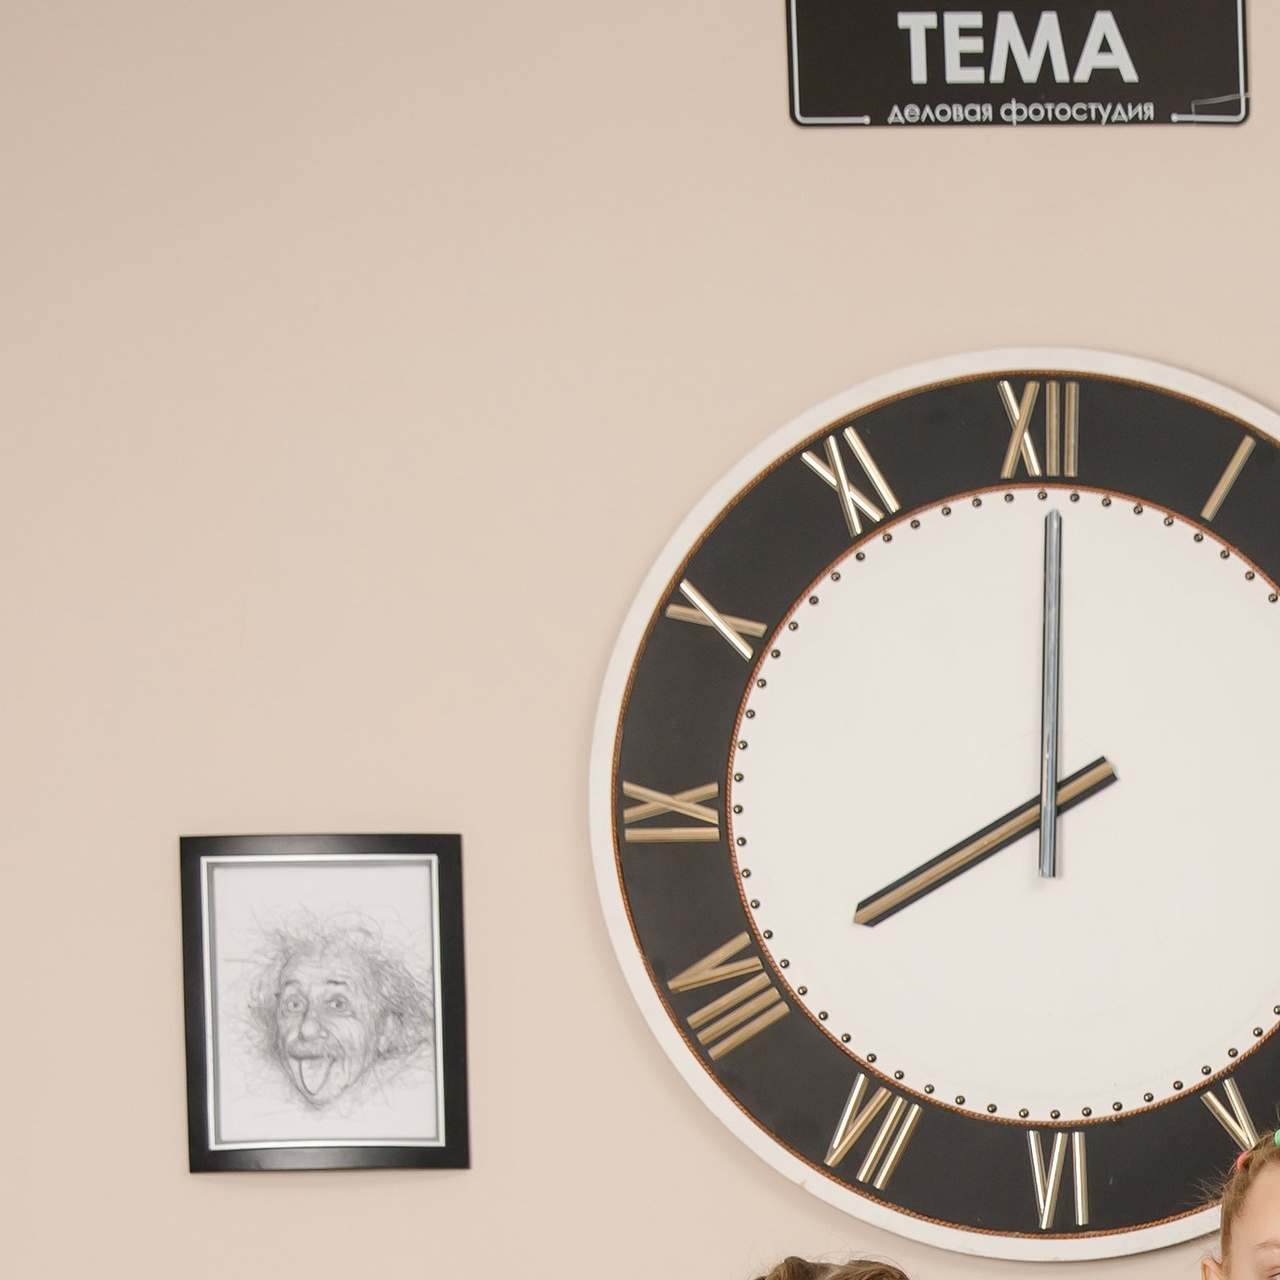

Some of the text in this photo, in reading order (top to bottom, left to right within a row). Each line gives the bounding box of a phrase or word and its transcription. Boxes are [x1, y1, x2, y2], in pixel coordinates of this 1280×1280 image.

[897, 10, 1139, 84] ТЕМА
[887, 98, 1155, 126] деловая фотостудия
[997, 379, 1080, 479] XII
[1026, 1130, 1089, 1231] VI
